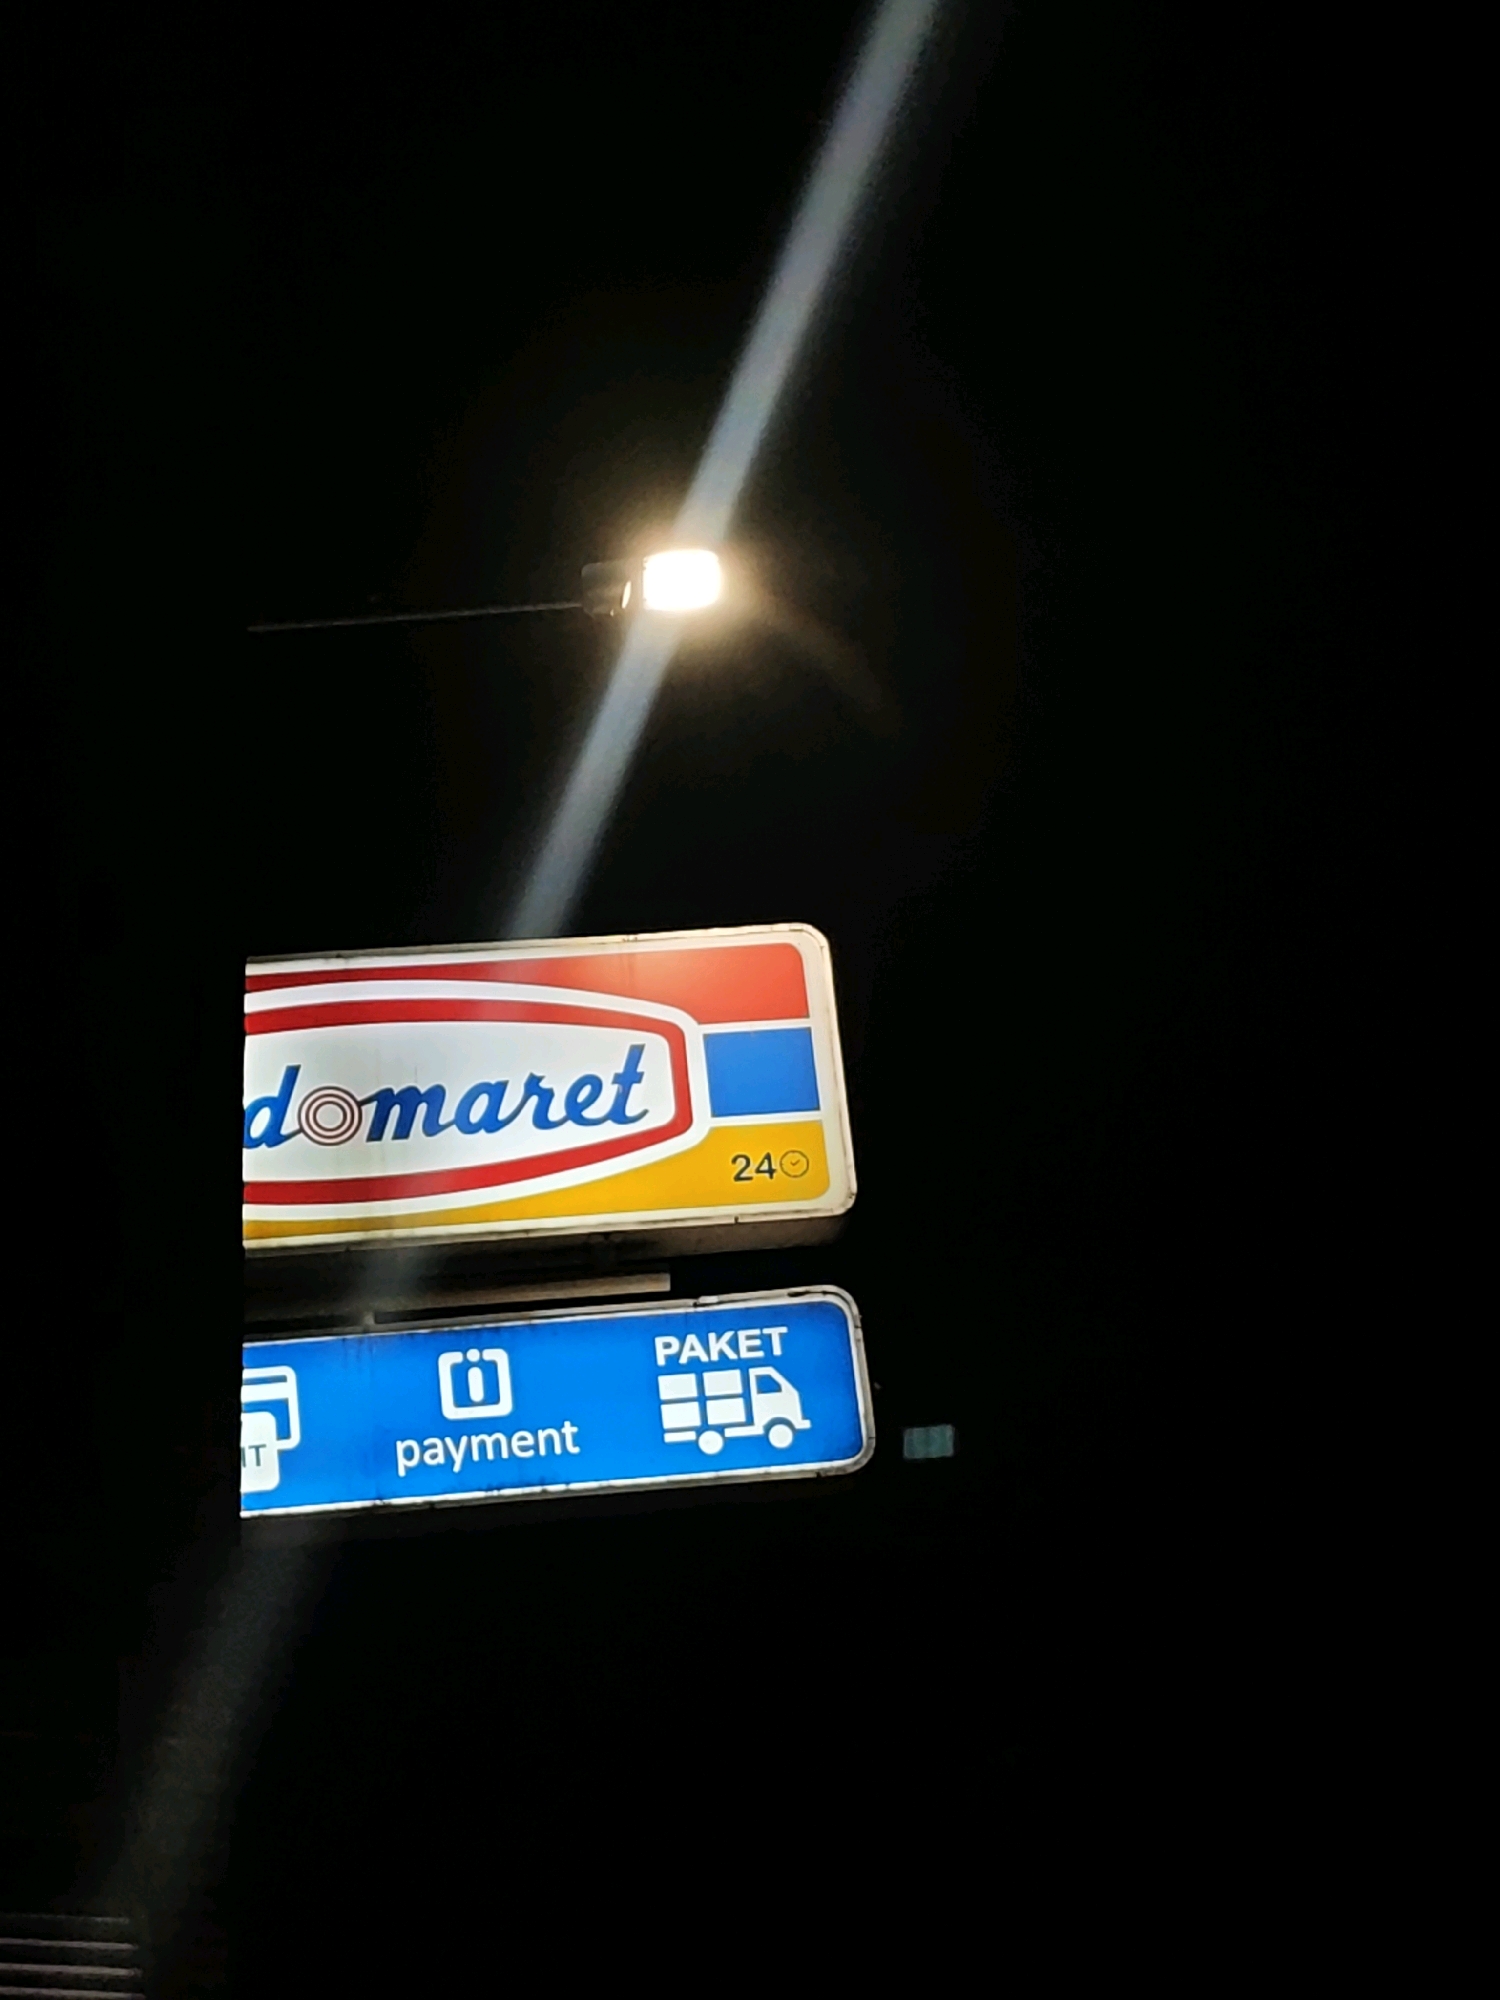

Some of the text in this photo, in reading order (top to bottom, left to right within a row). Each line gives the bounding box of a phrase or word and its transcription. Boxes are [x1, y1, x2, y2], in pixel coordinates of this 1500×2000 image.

[731, 1152, 777, 1182] 24
[654, 1326, 789, 1367] PAKET
[395, 1420, 581, 1478] payment
